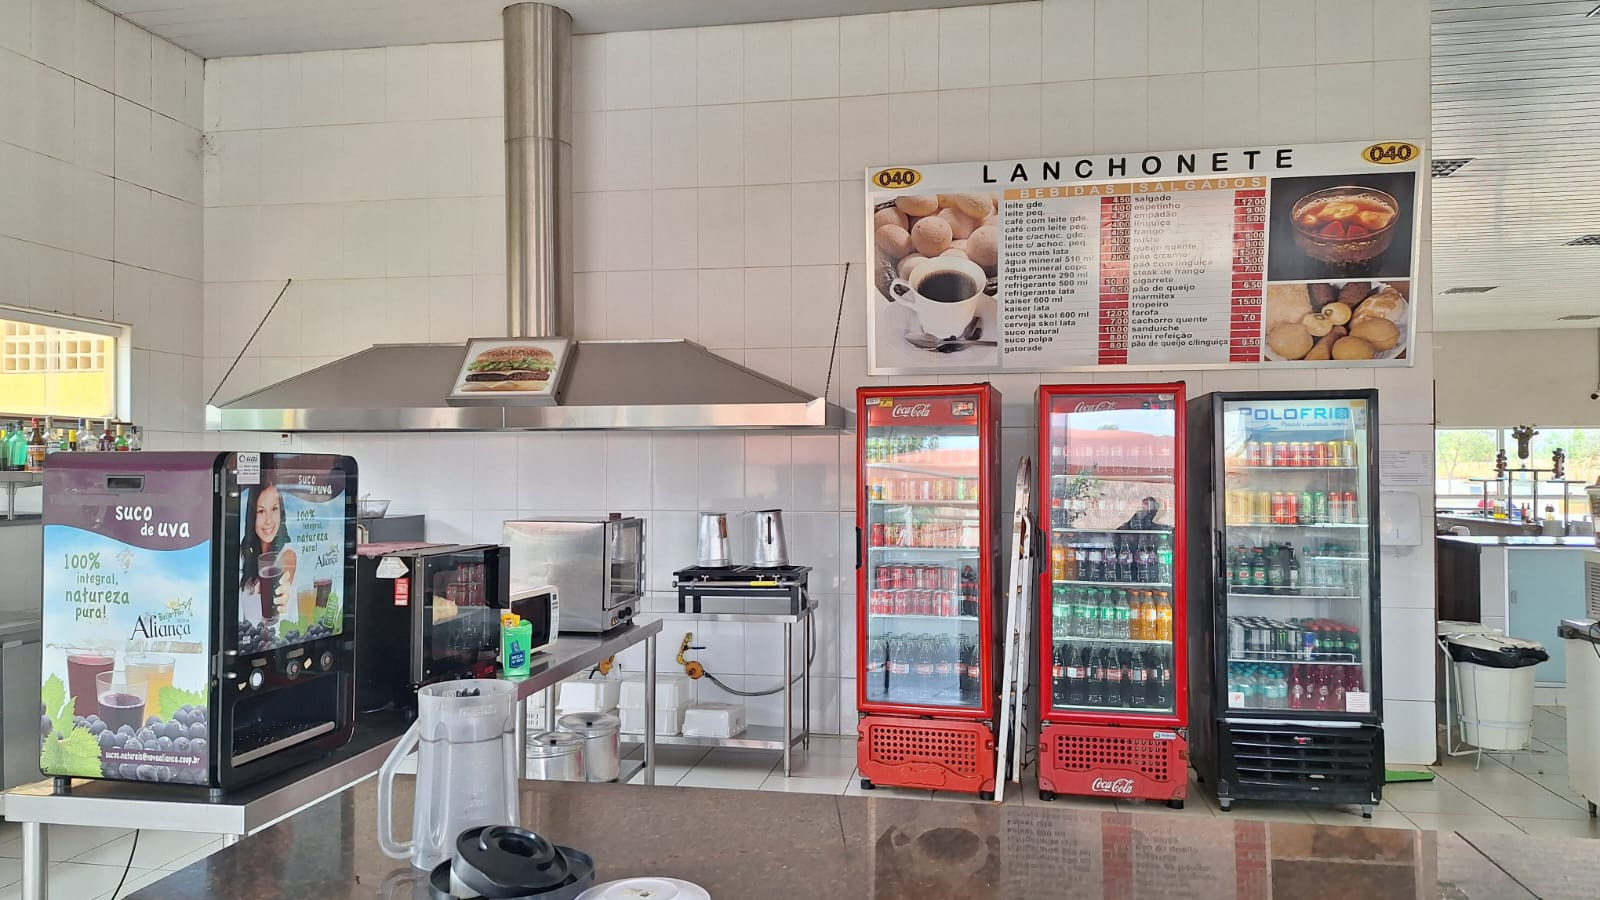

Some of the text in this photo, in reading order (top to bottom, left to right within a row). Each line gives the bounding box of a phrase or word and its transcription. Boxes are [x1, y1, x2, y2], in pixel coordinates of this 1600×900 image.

[1369, 144, 1411, 161] 040
[983, 149, 1293, 183] LANCHONETE
[879, 171, 915, 186] 040
[1140, 177, 1261, 192] SALGADOS
[1020, 185, 1115, 198] BEBIDAS
[1005, 201, 1045, 209] leite gde.
[1134, 203, 1180, 211] espetinho
[1029, 256, 1062, 264] mineral
[1029, 264, 1062, 272] mineral
[1175, 267, 1205, 275] frango
[1005, 281, 1056, 289] refrigerante
[1132, 285, 1149, 293] pão
[1166, 284, 1195, 292] queijo
[1005, 313, 1036, 321] cerveja
[1004, 345, 1042, 354] gatorade
[298, 474, 316, 485] suco
[115, 505, 153, 522] suco
[297, 509, 315, 521] 100%
[140, 522, 190, 538] de uva
[297, 532, 328, 542] natureza
[302, 543, 317, 555] pura!
[63, 552, 101, 570] 100%
[76, 573, 119, 586] integral,
[65, 588, 130, 605] natureza
[75, 605, 106, 621] pura!
[130, 615, 191, 640] Aliança
[1092, 778, 1135, 793] Coca-Cola
